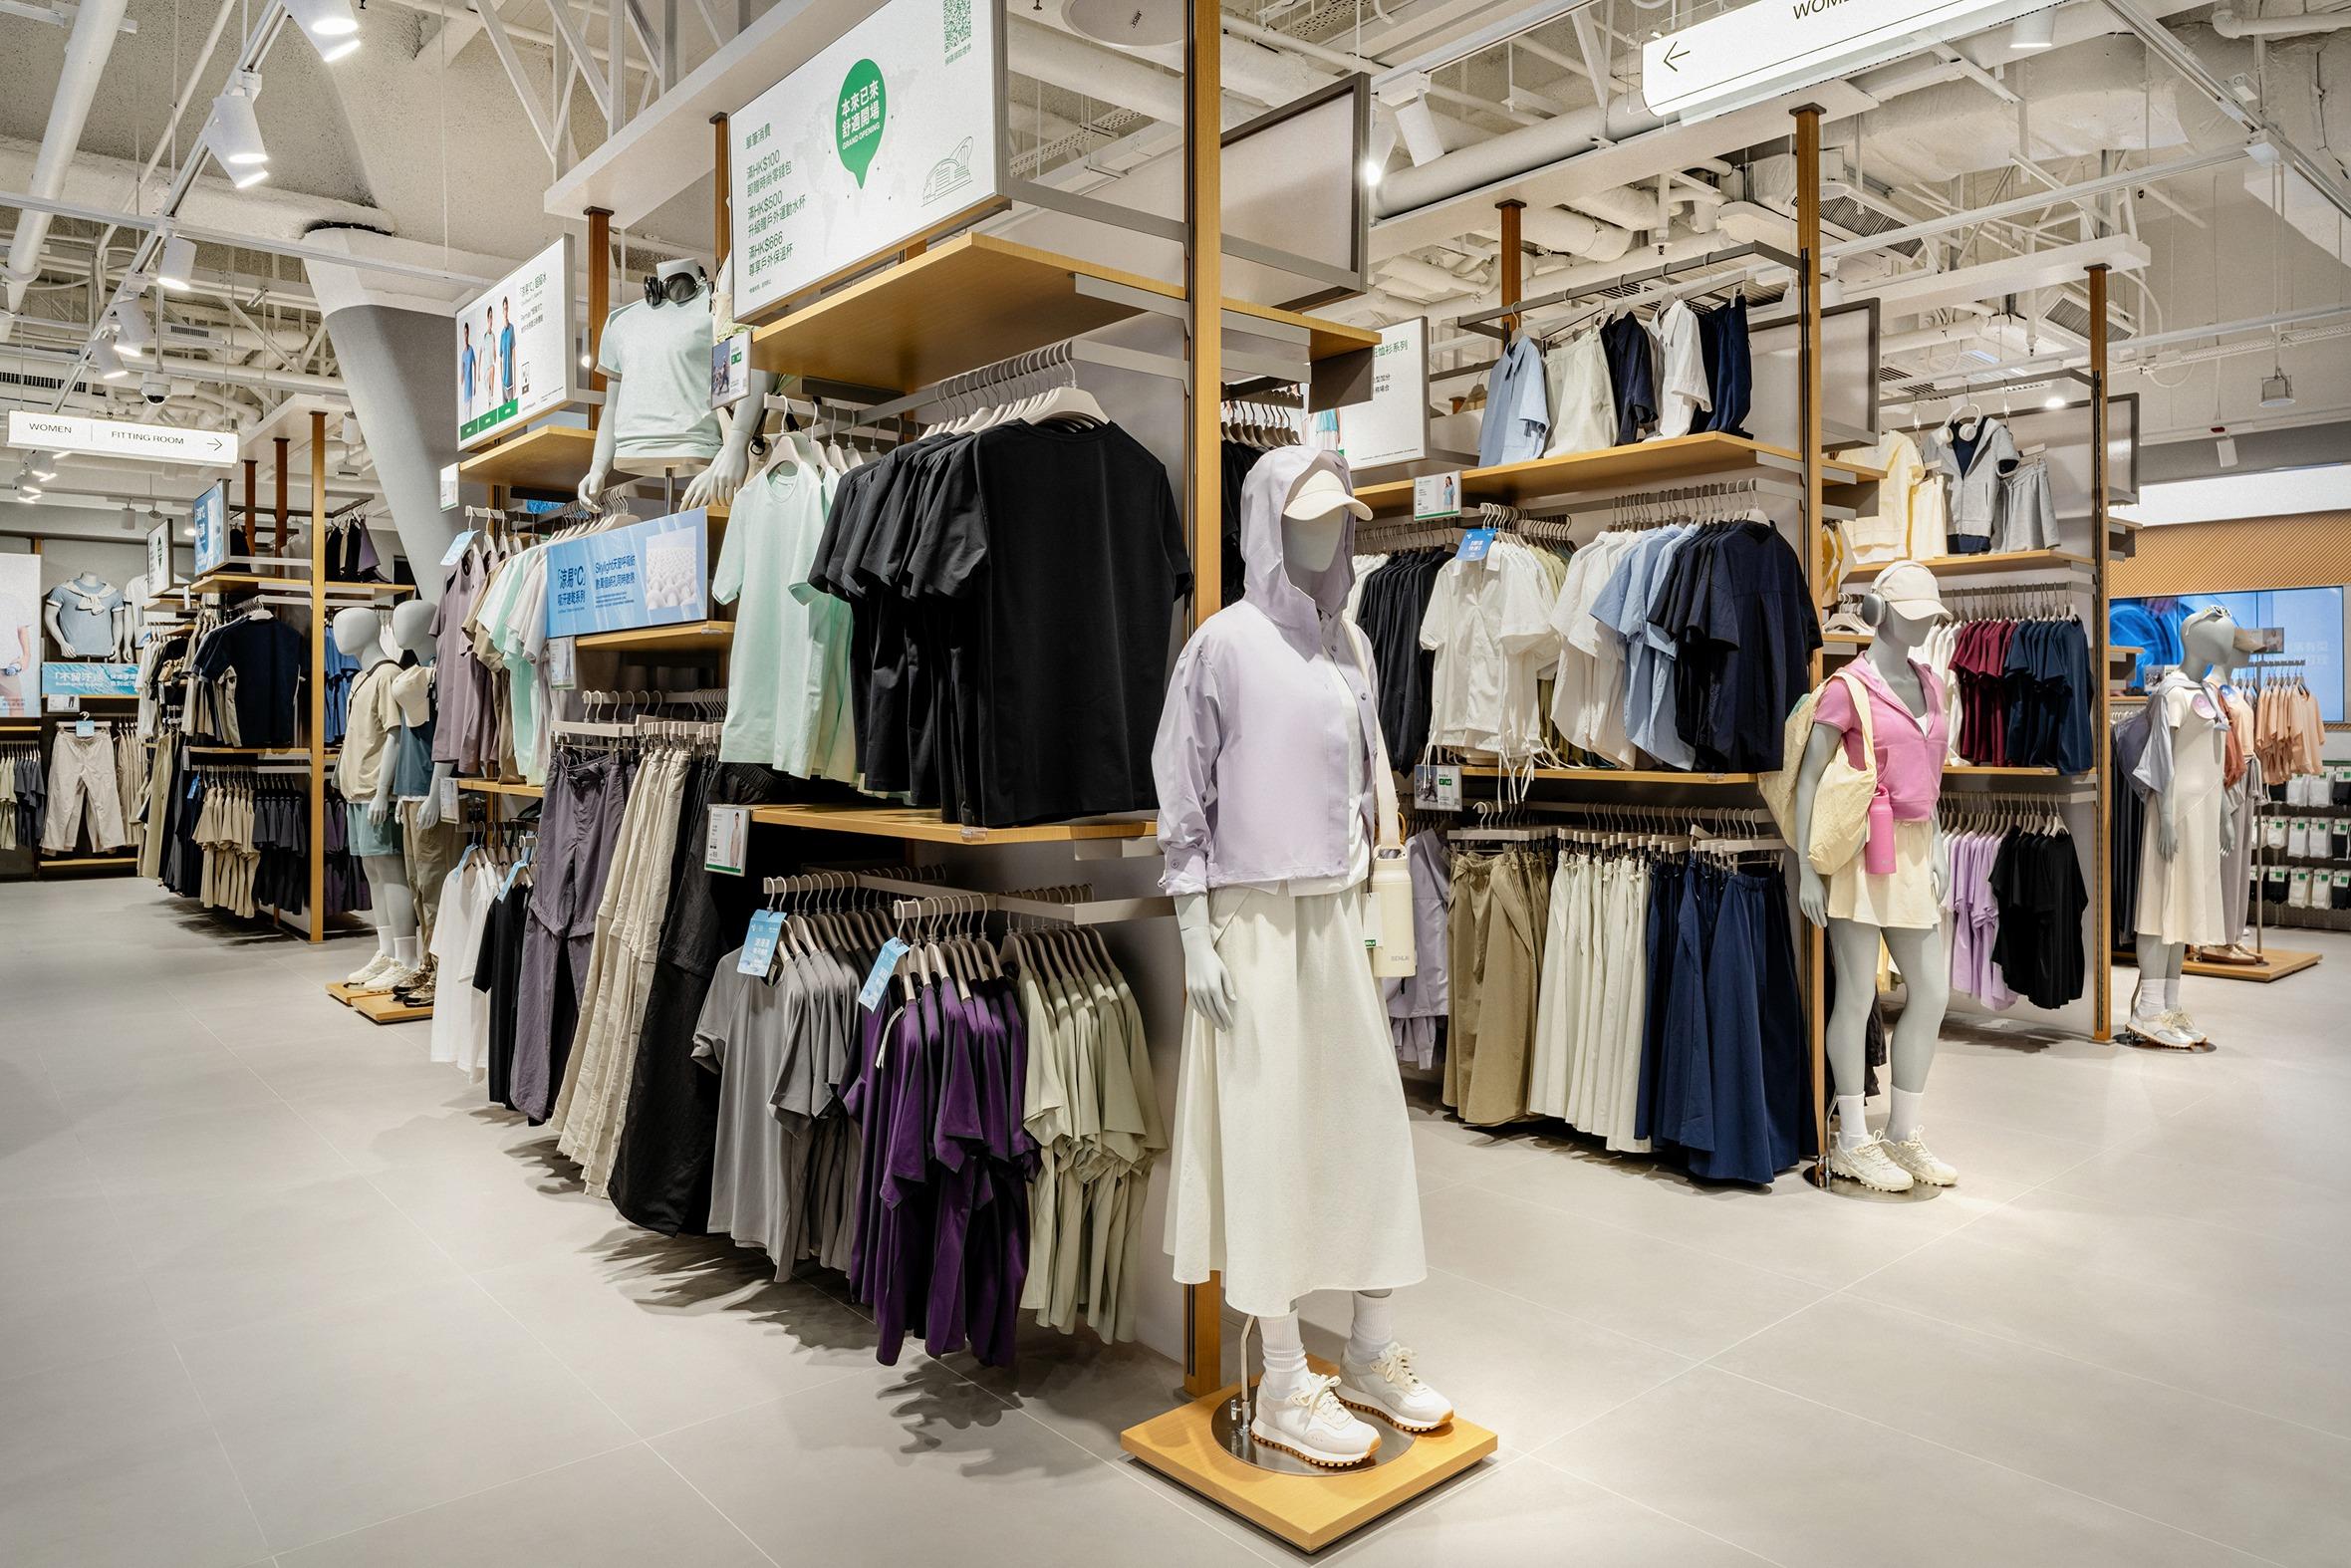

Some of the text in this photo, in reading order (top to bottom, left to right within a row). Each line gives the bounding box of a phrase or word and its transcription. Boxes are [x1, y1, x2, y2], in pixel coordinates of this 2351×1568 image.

[1793, 0, 1850, 20] WOM
[841, 80, 880, 117] 本來已來
[842, 100, 881, 138] 舒適開場
[842, 122, 881, 150] GRAND OPENING
[1375, 339, 1409, 358] 恤衫系列
[29, 422, 73, 433] WOMEN
[111, 430, 185, 445] FITTING ROOM
